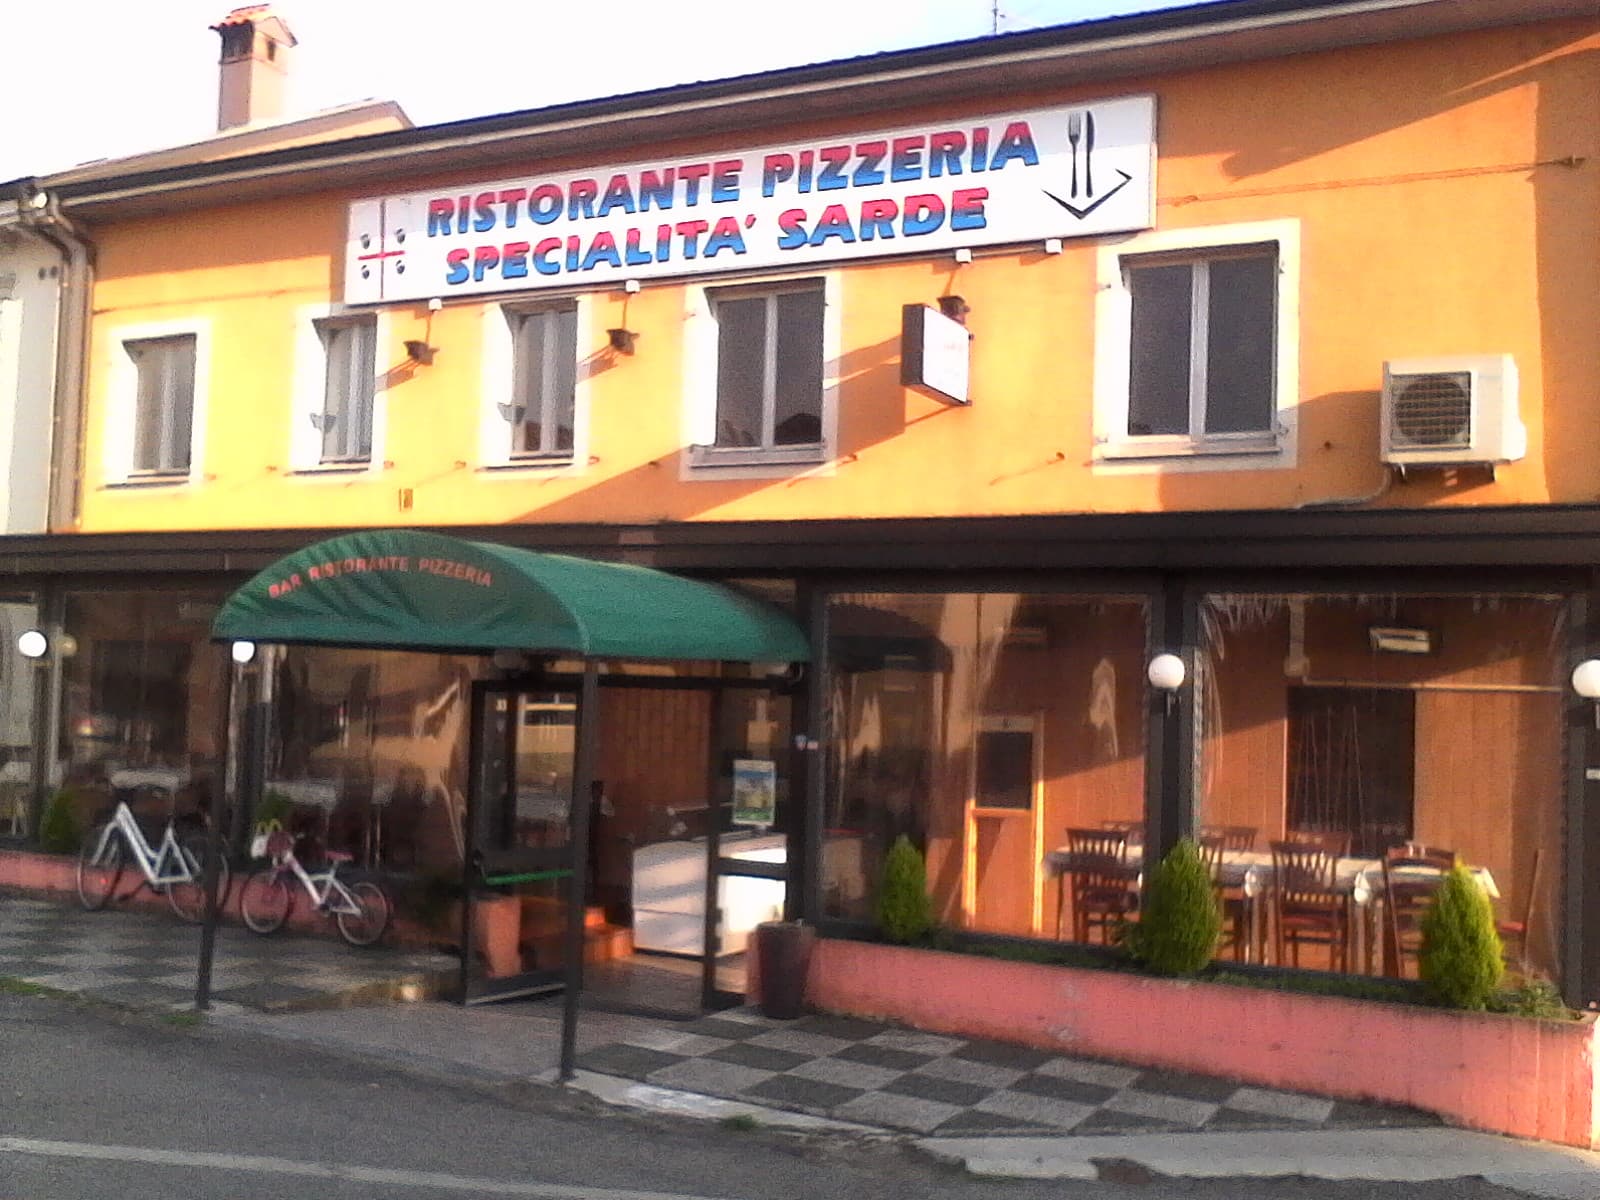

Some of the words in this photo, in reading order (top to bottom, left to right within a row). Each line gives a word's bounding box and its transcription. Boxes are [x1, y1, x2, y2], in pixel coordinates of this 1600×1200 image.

[427, 159, 743, 237] RISTORANTE
[762, 121, 1039, 197] PIZZERIA
[446, 214, 756, 285] SPECIALITA'
[778, 187, 989, 250] SARDE
[268, 574, 303, 598] BAR
[308, 556, 409, 581] RISTORANTE
[418, 558, 492, 587] PIZZERIA
